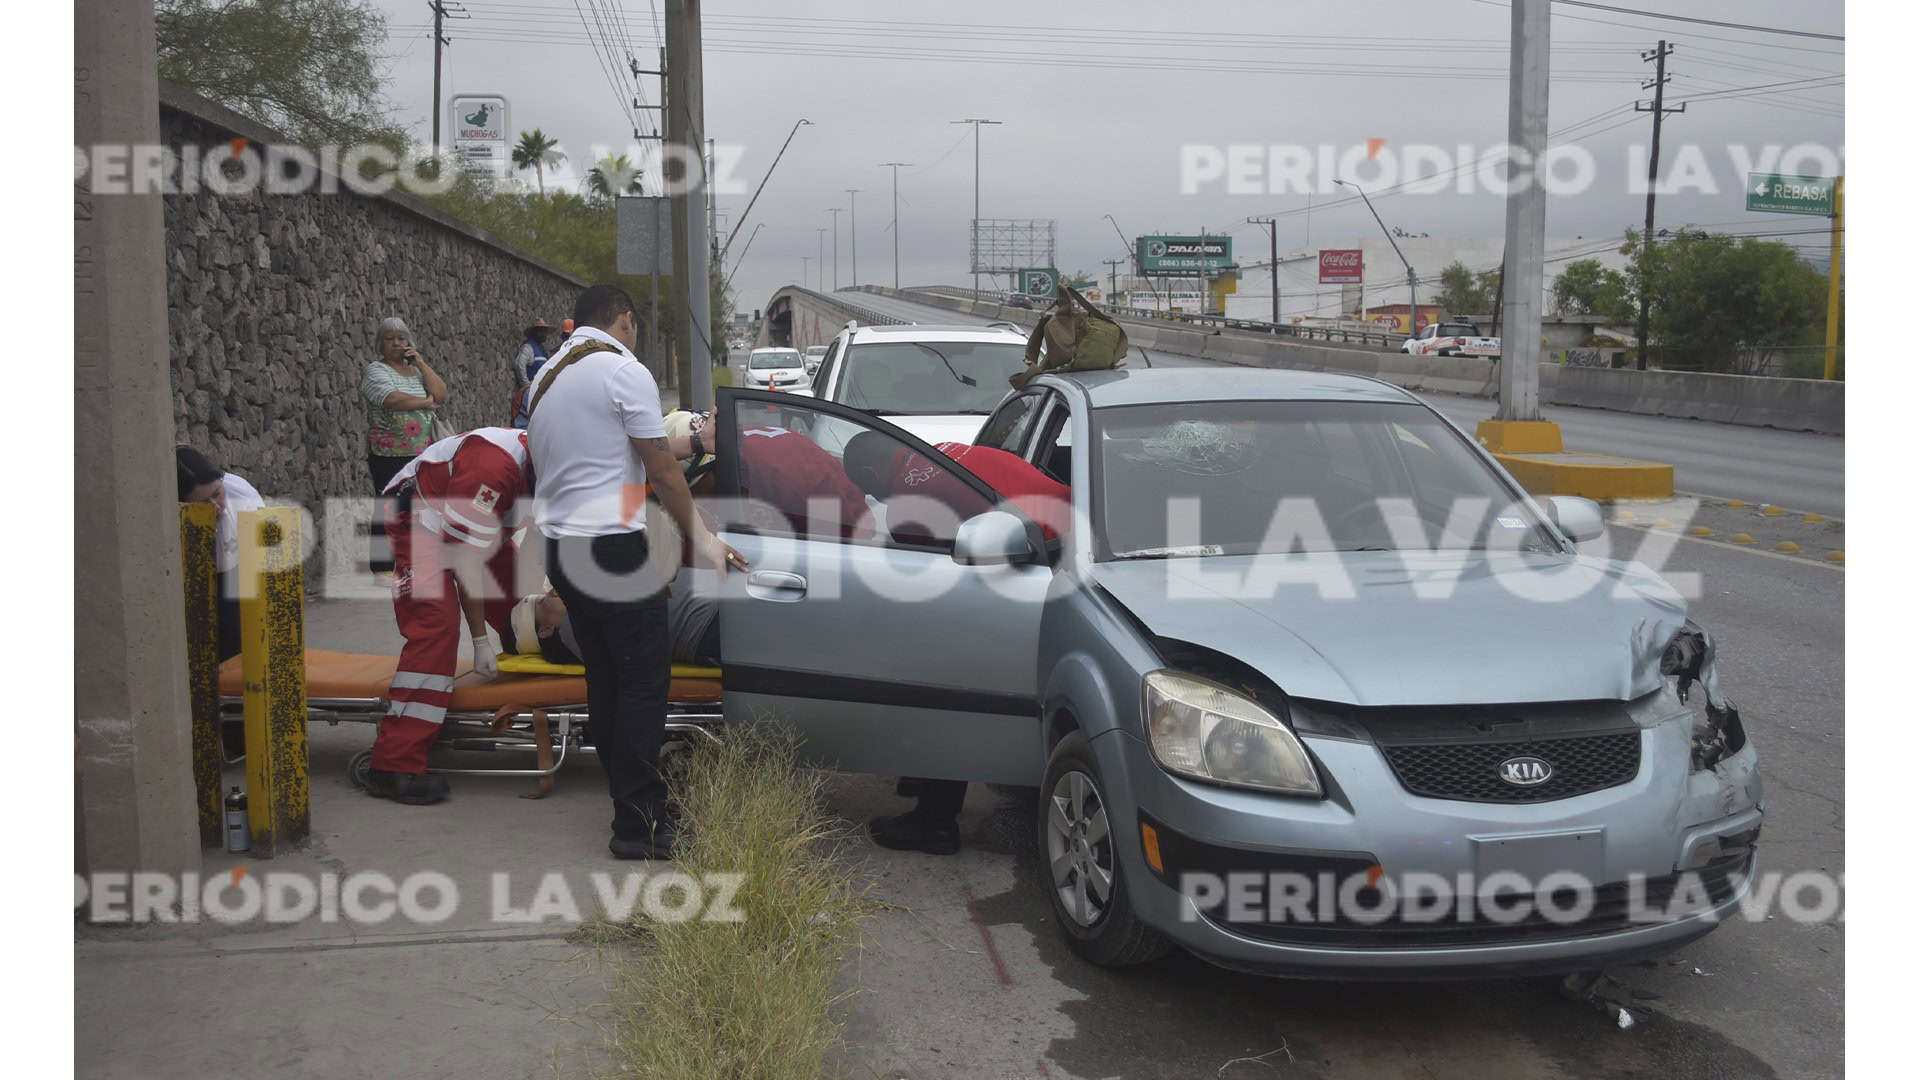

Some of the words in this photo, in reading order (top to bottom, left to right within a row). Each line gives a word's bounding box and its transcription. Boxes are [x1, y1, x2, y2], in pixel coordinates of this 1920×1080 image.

[1772, 184, 1828, 201] REBASA
[1321, 251, 1359, 268] Coca-Cola
[1506, 762, 1545, 778] KIA
